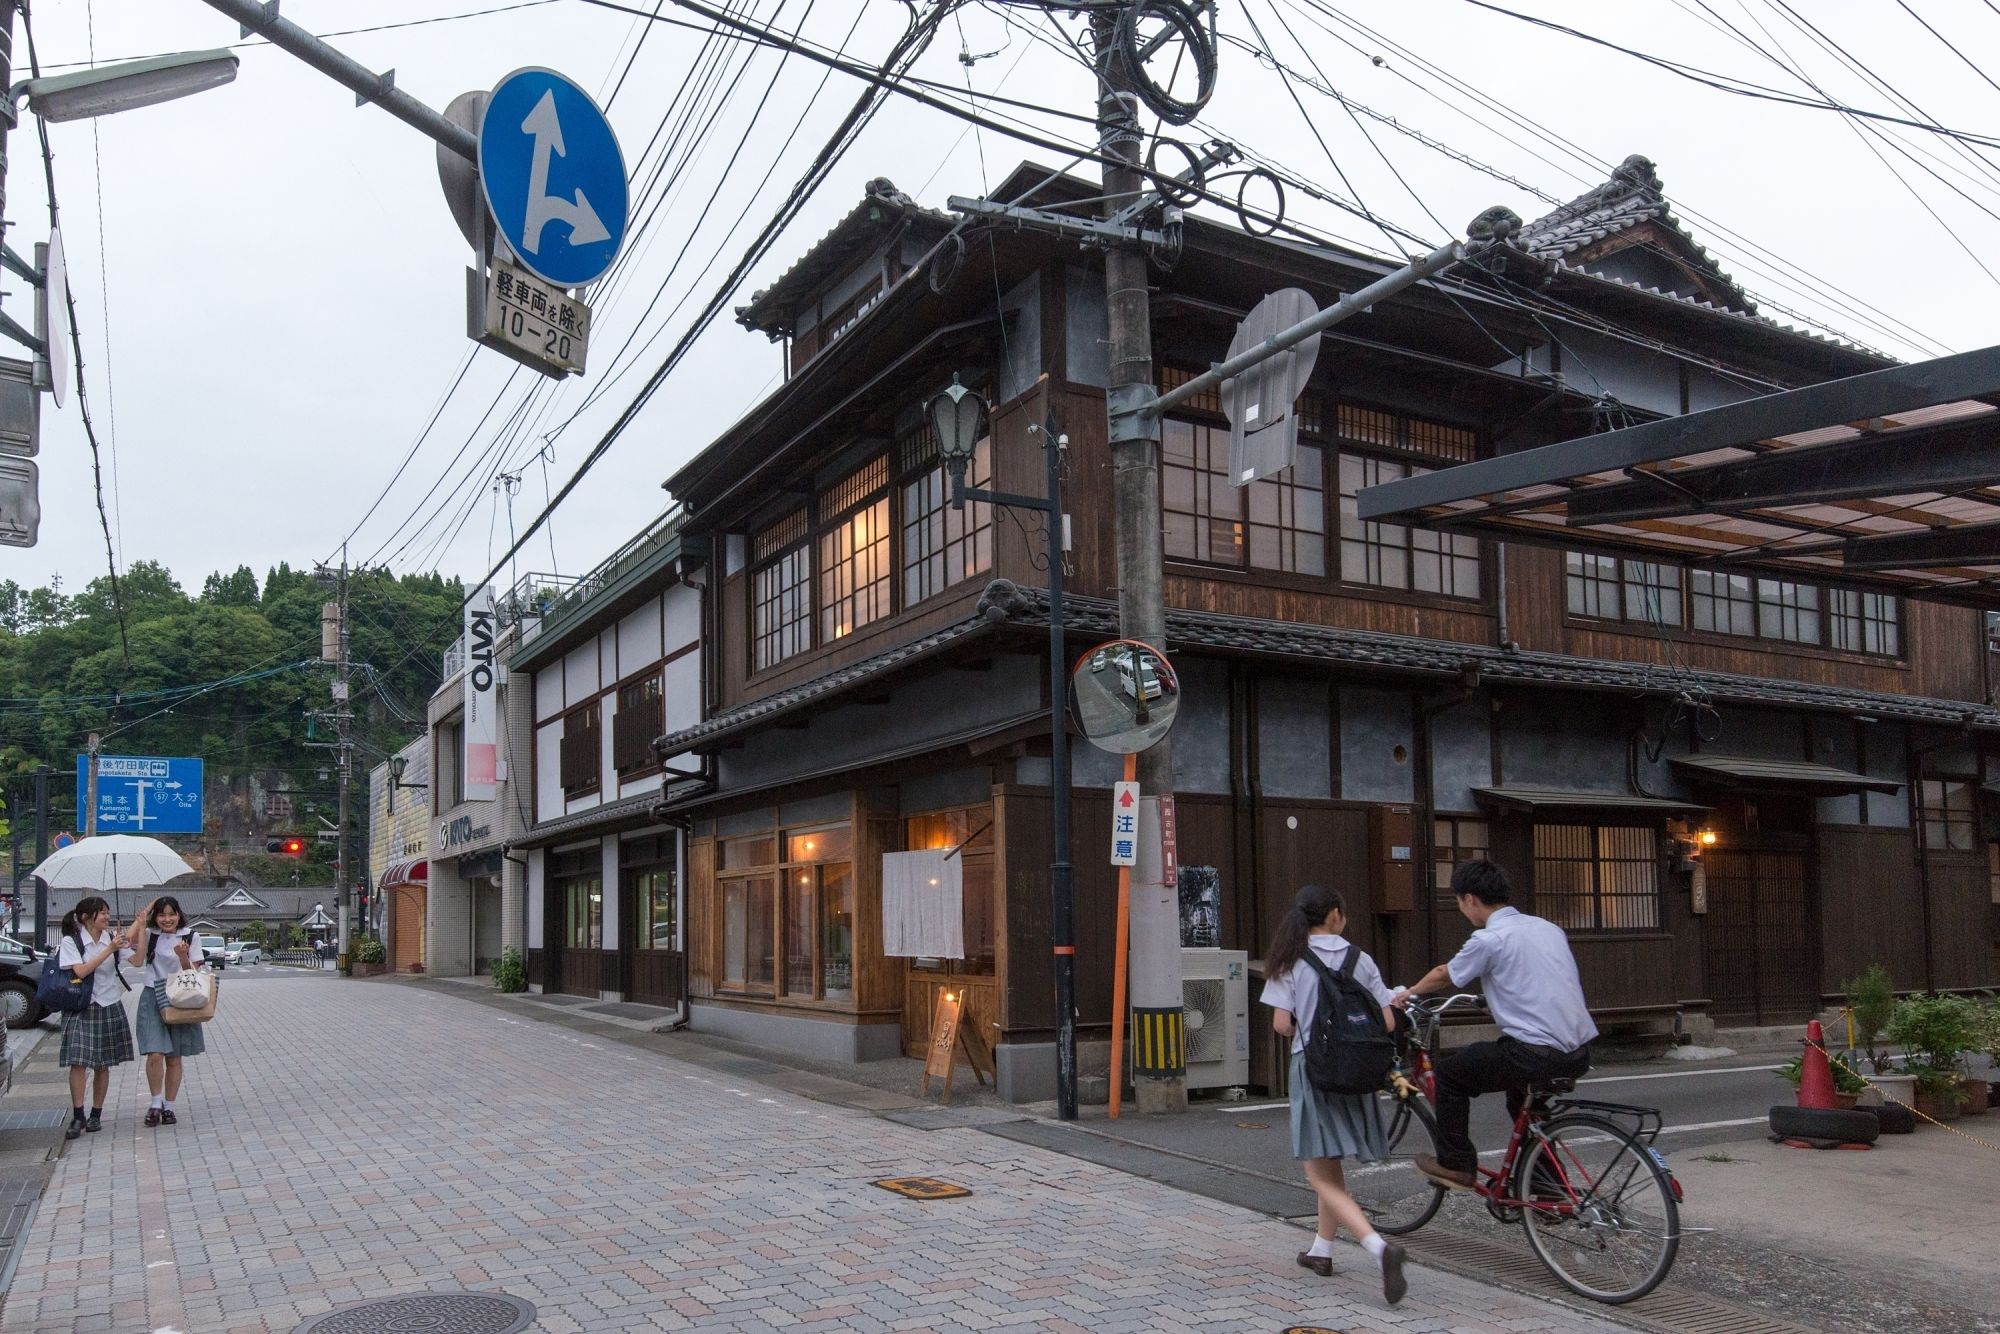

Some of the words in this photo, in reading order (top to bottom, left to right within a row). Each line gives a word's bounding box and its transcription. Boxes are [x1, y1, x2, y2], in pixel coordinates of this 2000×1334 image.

[496, 269, 584, 336] 軽車両を除く
[471, 610, 494, 692] KATO
[102, 795, 128, 805] 熊本
[172, 792, 198, 802] 大分
[119, 813, 126, 821] 8
[1116, 815, 1133, 858] 注意
